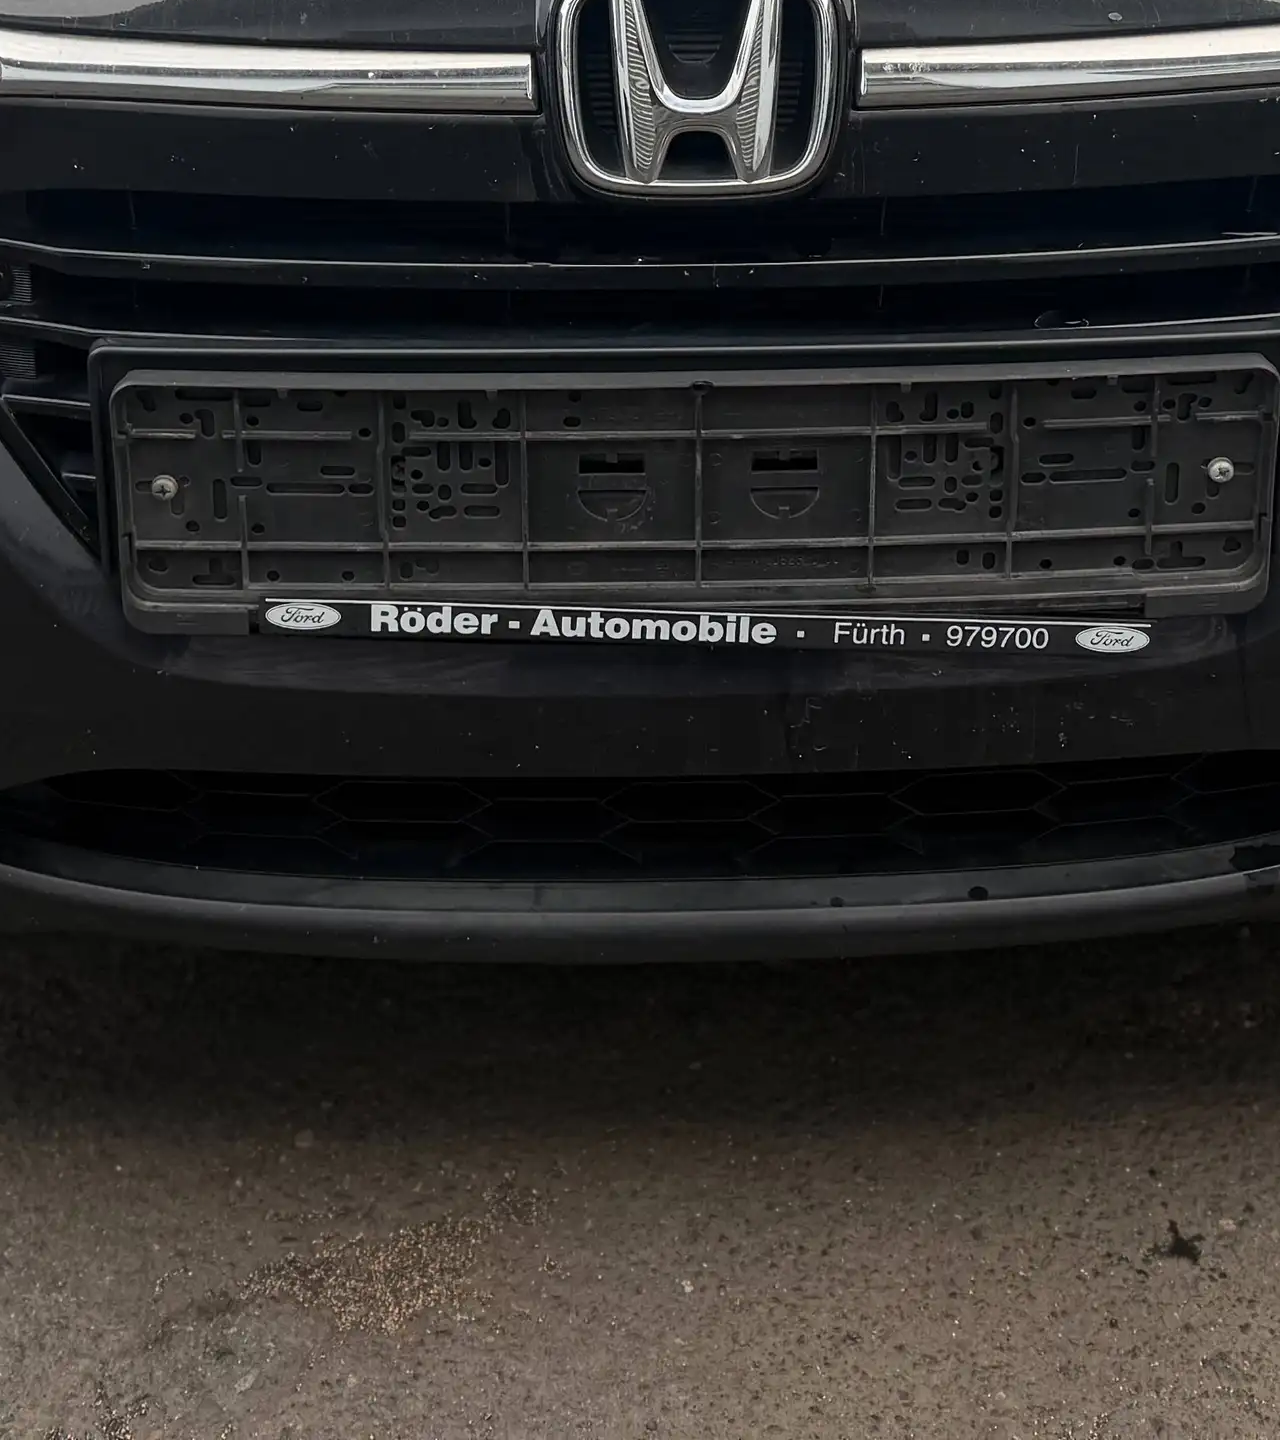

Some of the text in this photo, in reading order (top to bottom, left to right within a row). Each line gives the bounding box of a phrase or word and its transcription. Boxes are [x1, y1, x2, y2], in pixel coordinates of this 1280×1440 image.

[370, 603, 499, 635] Röder
[529, 608, 778, 646] Automobile
[833, 621, 906, 646] Fürth
[946, 625, 1049, 650] 979700
